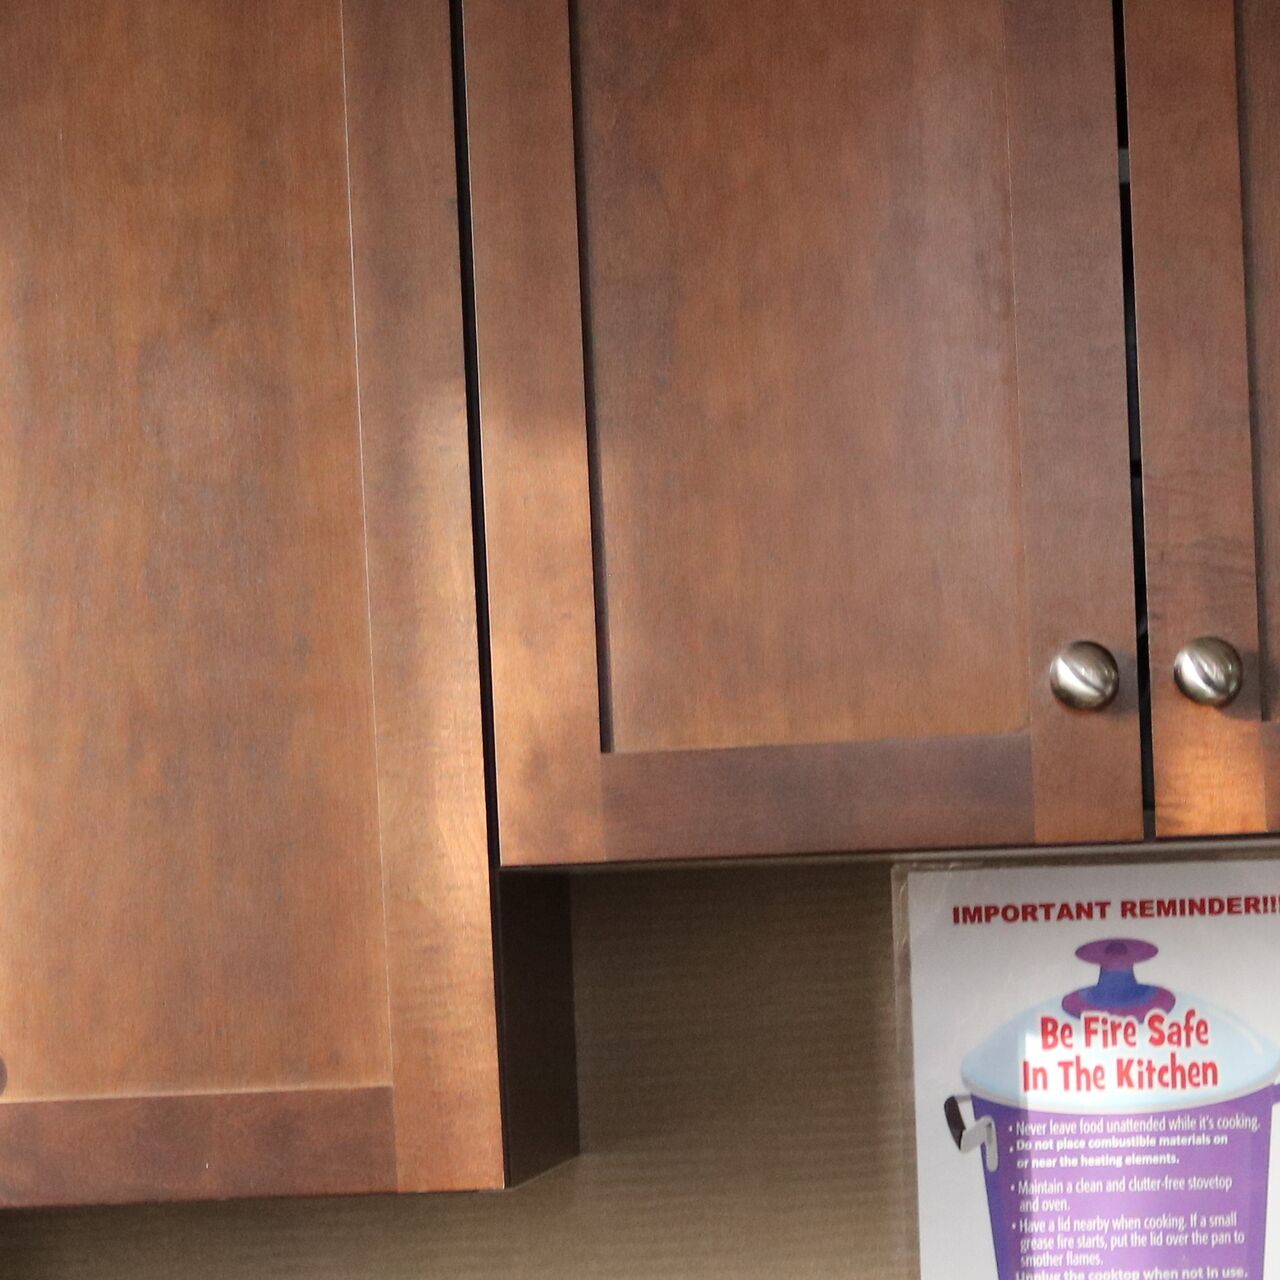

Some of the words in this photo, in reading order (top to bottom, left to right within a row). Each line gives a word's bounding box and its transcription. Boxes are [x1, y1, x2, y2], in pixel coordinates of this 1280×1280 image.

[952, 901, 1111, 925] IMPORTANT
[1040, 1016, 1074, 1050] Be
[1084, 1015, 1137, 1048] Fire
[1147, 1009, 1209, 1048] Safe
[1023, 1059, 1048, 1092] In
[1058, 1055, 1106, 1092] The
[1116, 1051, 1219, 1090] Kitchen
[1016, 1121, 1047, 1136] Never
[1049, 1118, 1077, 1135] leave
[1080, 1117, 1104, 1134] food
[1107, 1115, 1166, 1133] unattended
[1168, 1114, 1197, 1131] while
[1200, 1113, 1214, 1130] it's
[1016, 1139, 1032, 1151] Do
[1034, 1138, 1054, 1151] not
[1056, 1137, 1086, 1153] place
[1088, 1134, 1156, 1149] combustible
[1159, 1133, 1211, 1146] materials
[1214, 1134, 1228, 1145] on
[1017, 1159, 1029, 1168] or
[1032, 1157, 1057, 1168] near
[1060, 1155, 1078, 1167] the
[1080, 1154, 1123, 1168] heating
[1125, 1152, 1180, 1166] elements.
[1018, 1177, 1064, 1195] Maintain
[1066, 1181, 1073, 1194] a
[1075, 1177, 1103, 1193] clean
[1106, 1175, 1126, 1193] and
[1128, 1174, 1185, 1192] clutter-free
[1188, 1174, 1233, 1192] stovetop
[1020, 1196, 1039, 1213] and
[1041, 1198, 1070, 1212] oven.
[1020, 1217, 1046, 1233] Have
[1048, 1220, 1055, 1233] a
[1057, 1215, 1070, 1232] lid
[1073, 1215, 1109, 1233] nearby
[1111, 1213, 1141, 1230] when
[1190, 1211, 1197, 1228] If
[1200, 1215, 1207, 1228] a
[1209, 1211, 1237, 1227] small
[1020, 1236, 1055, 1253] grease
[1056, 1233, 1075, 1249] fire
[1076, 1233, 1108, 1250] starts,
[1111, 1233, 1128, 1251] put
[1130, 1231, 1148, 1247] the
[1150, 1230, 1163, 1246] lid
[1166, 1232, 1189, 1246] over
[1191, 1230, 1209, 1245] the
[1211, 1231, 1231, 1248] pan
[1234, 1229, 1245, 1244] to
[1021, 1250, 1064, 1268] smother
[1066, 1250, 1103, 1266] flames.
[1143, 1266, 1179, 1280] when
[1182, 1266, 1203, 1279] not
